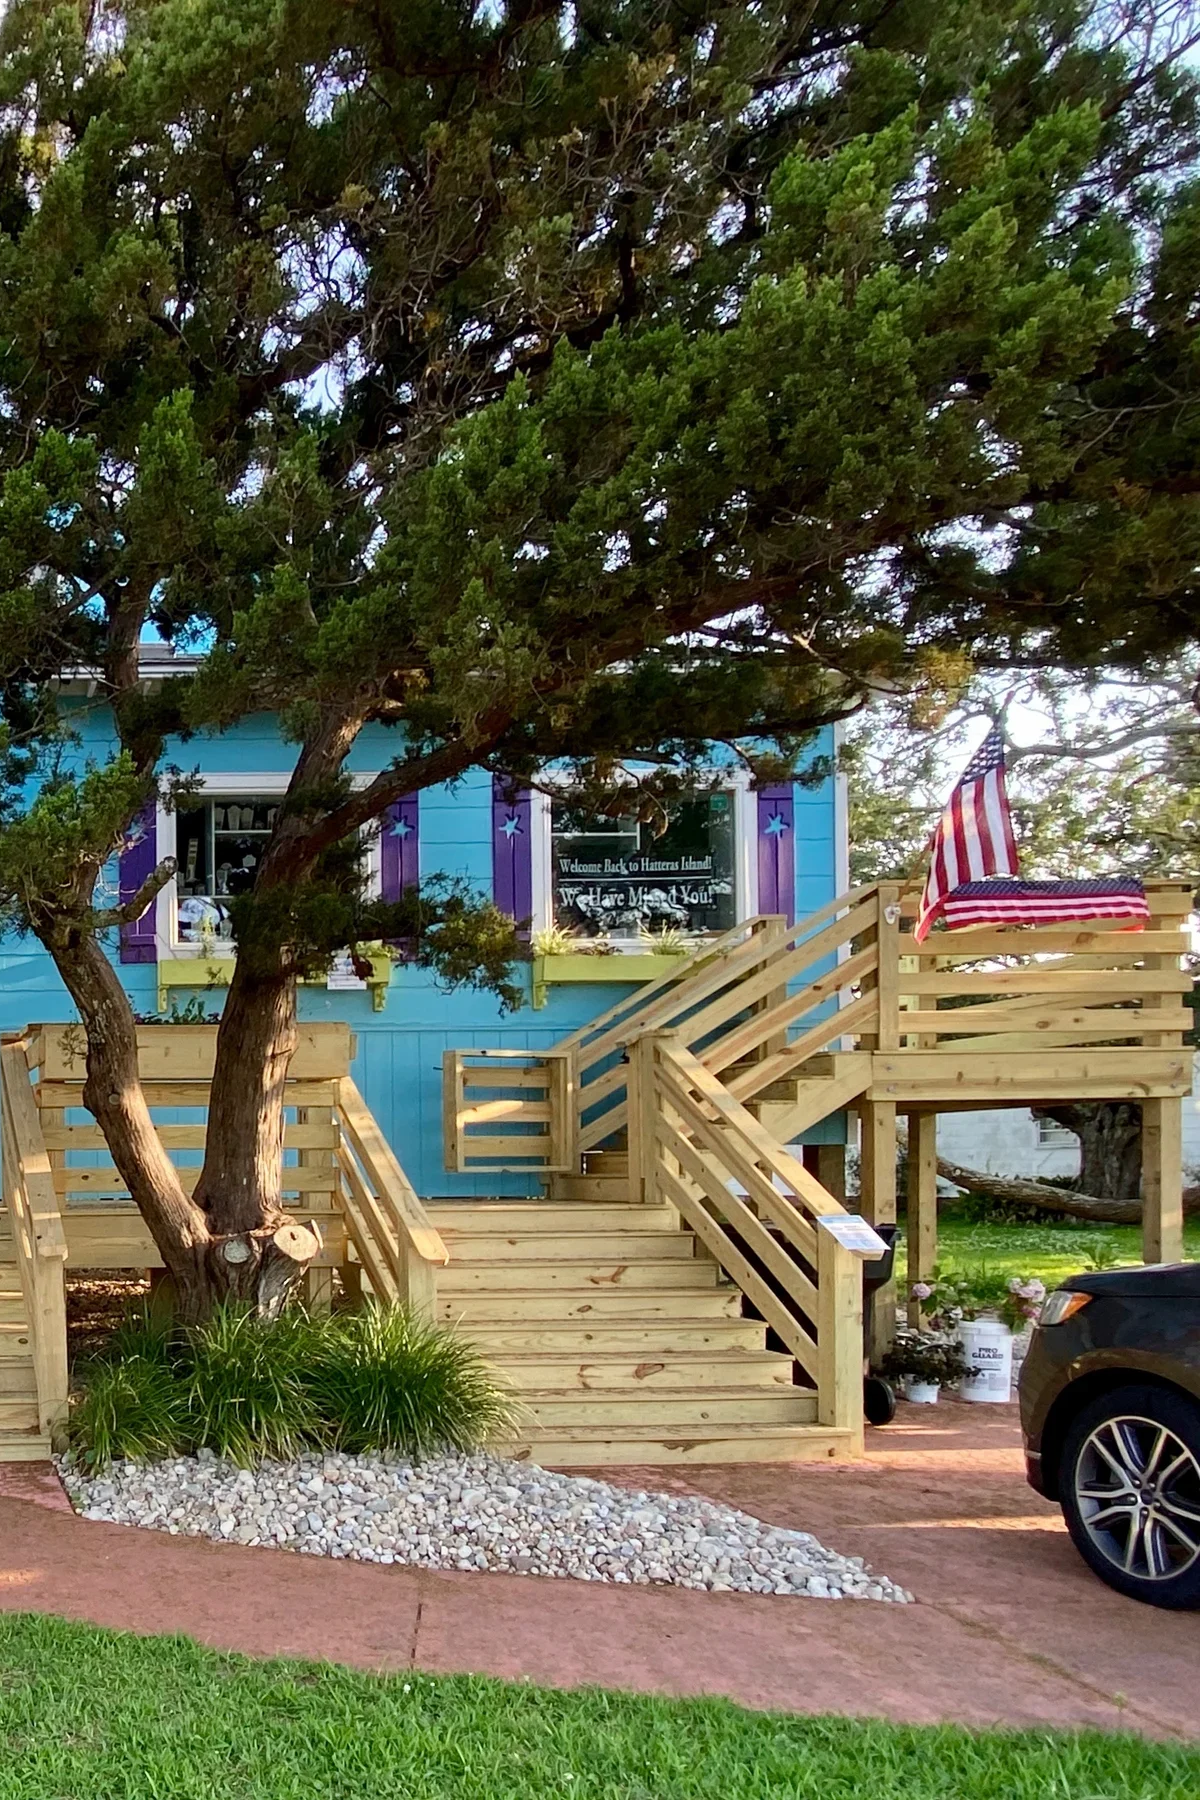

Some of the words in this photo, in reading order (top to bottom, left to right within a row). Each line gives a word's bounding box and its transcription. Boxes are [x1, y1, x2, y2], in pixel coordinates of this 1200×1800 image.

[559, 858, 602, 874] Welcome
[604, 858, 627, 873] Back
[629, 861, 639, 872] to
[641, 856, 679, 872] Hatteras
[681, 855, 712, 871] Island!
